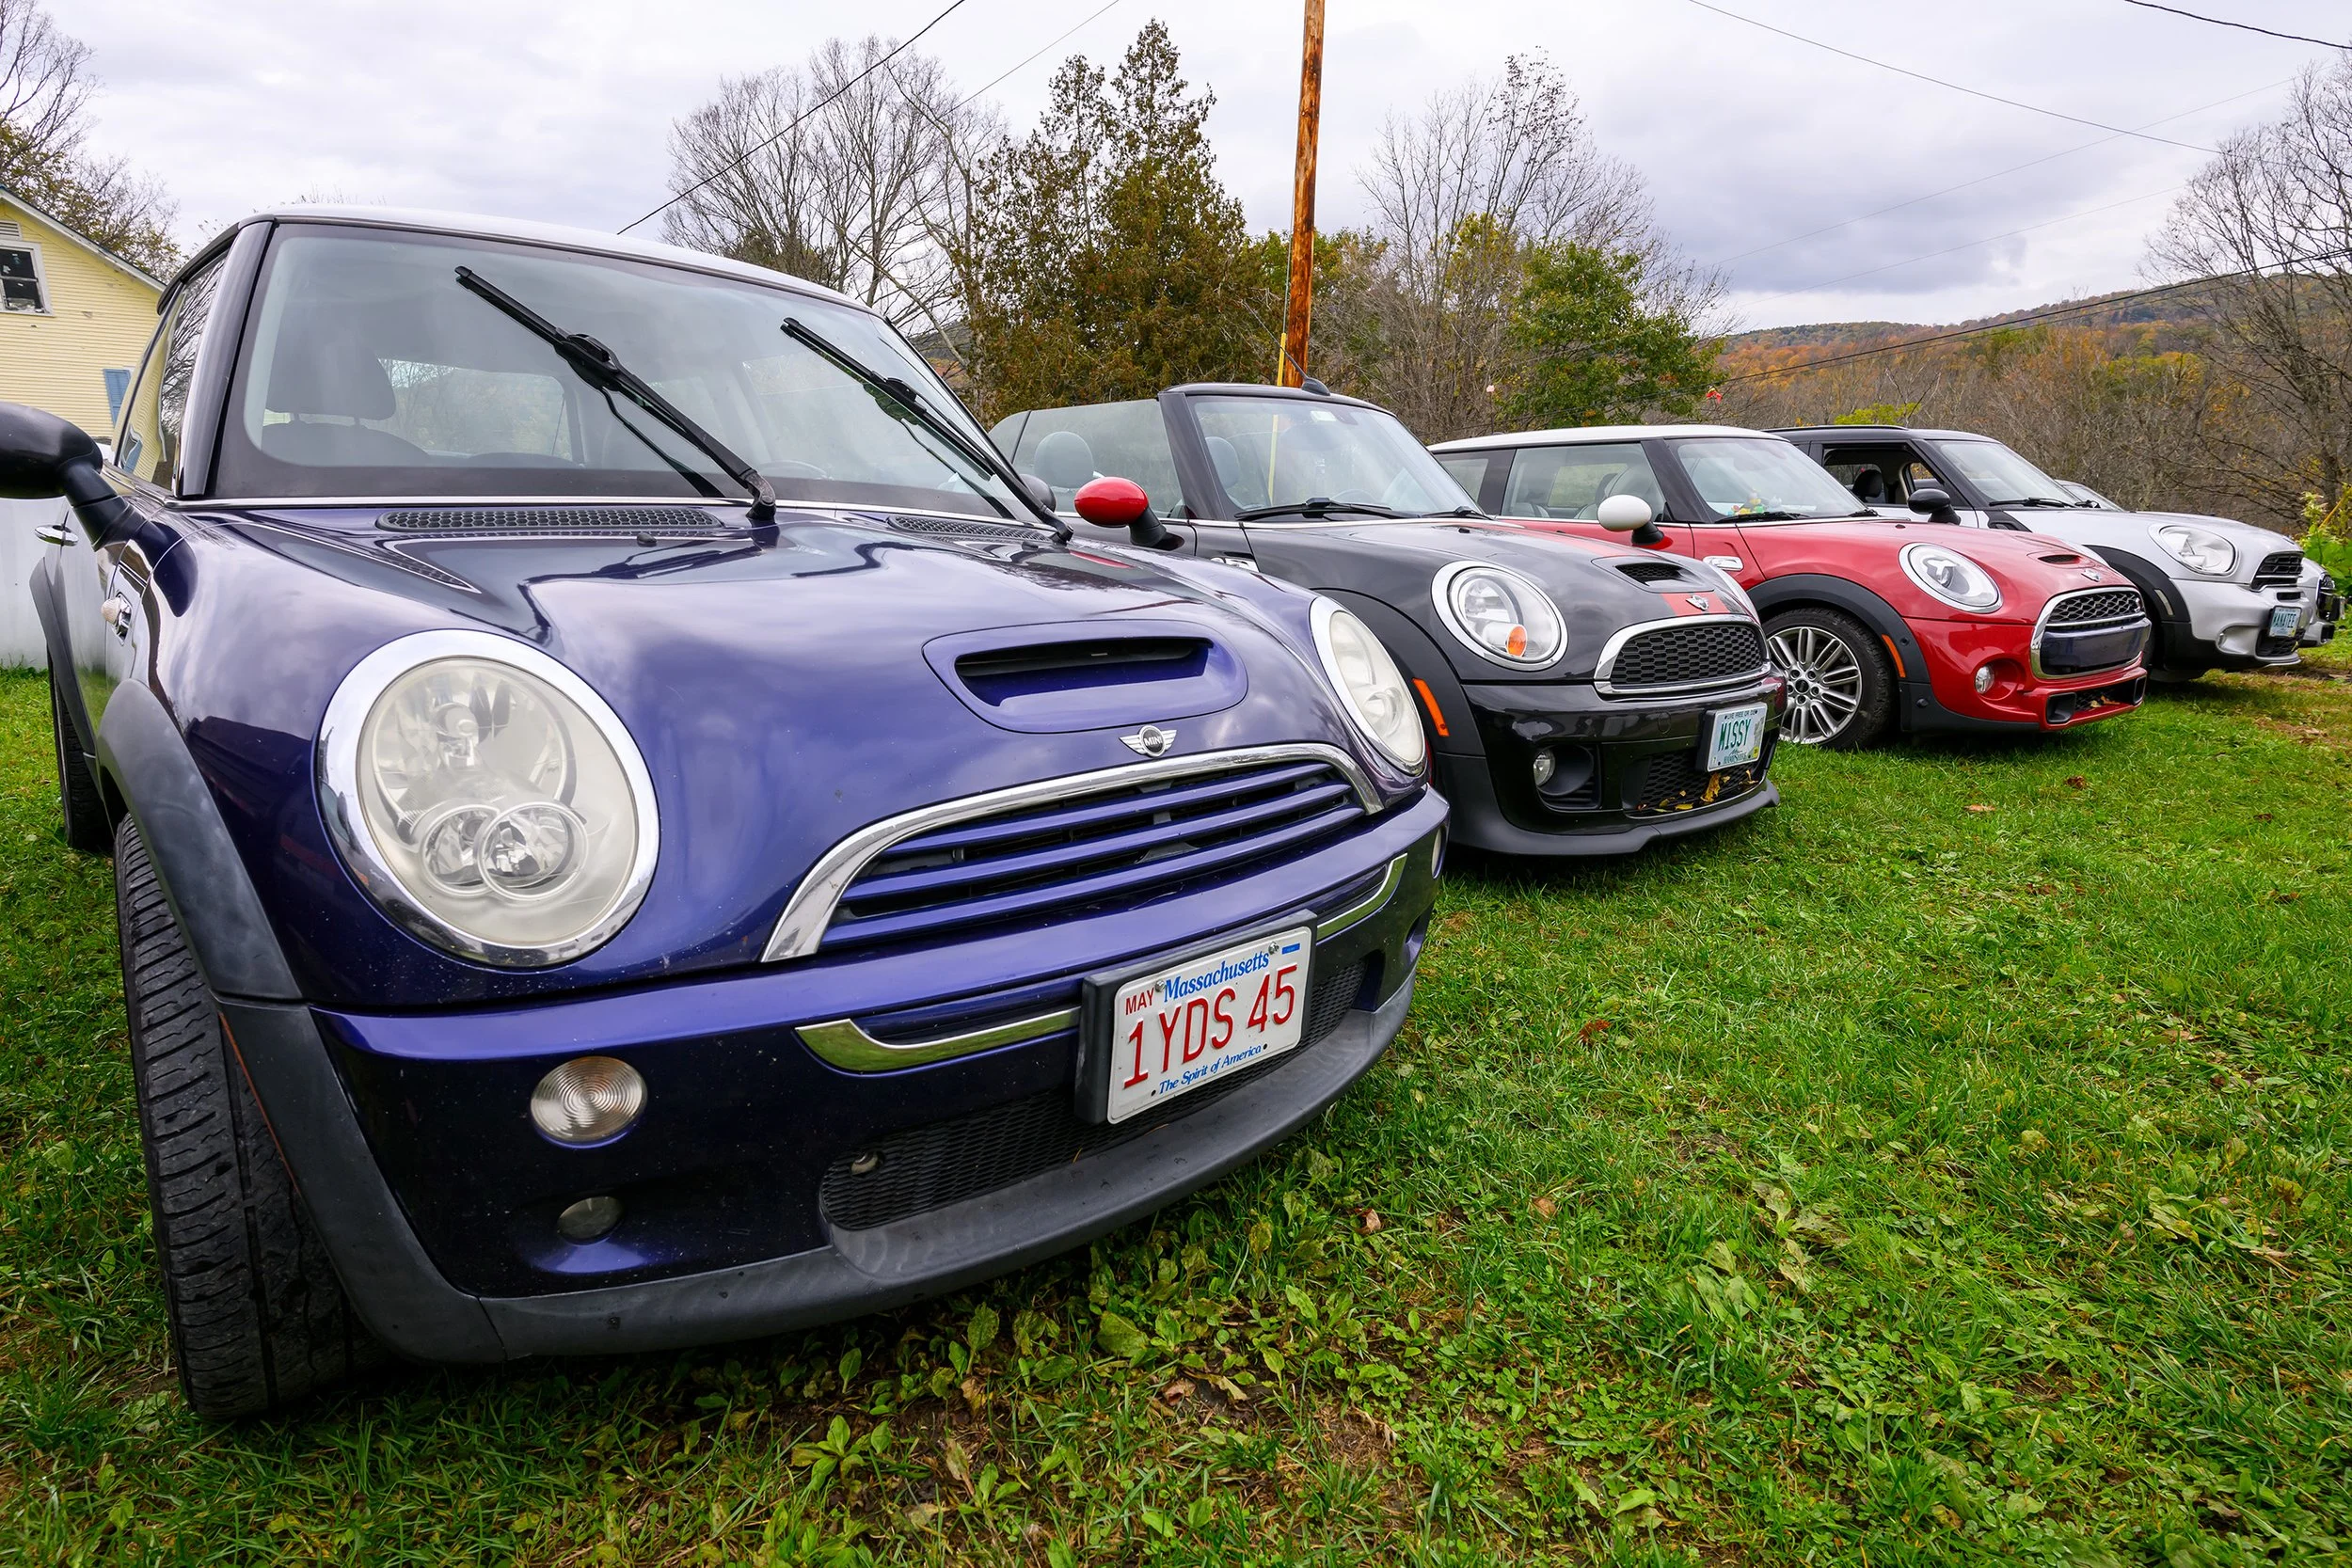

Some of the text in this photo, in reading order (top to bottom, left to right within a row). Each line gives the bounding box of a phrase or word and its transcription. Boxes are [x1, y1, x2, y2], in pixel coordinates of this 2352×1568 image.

[1144, 736, 1163, 746] MINI
[1718, 719, 1751, 752] MISSY
[1164, 952, 1269, 1003] Massachusetts
[1125, 988, 1154, 1016] MAY
[1123, 964, 1298, 1089] 1YDS 45
[1159, 1045, 1262, 1094] The Spirit of America
